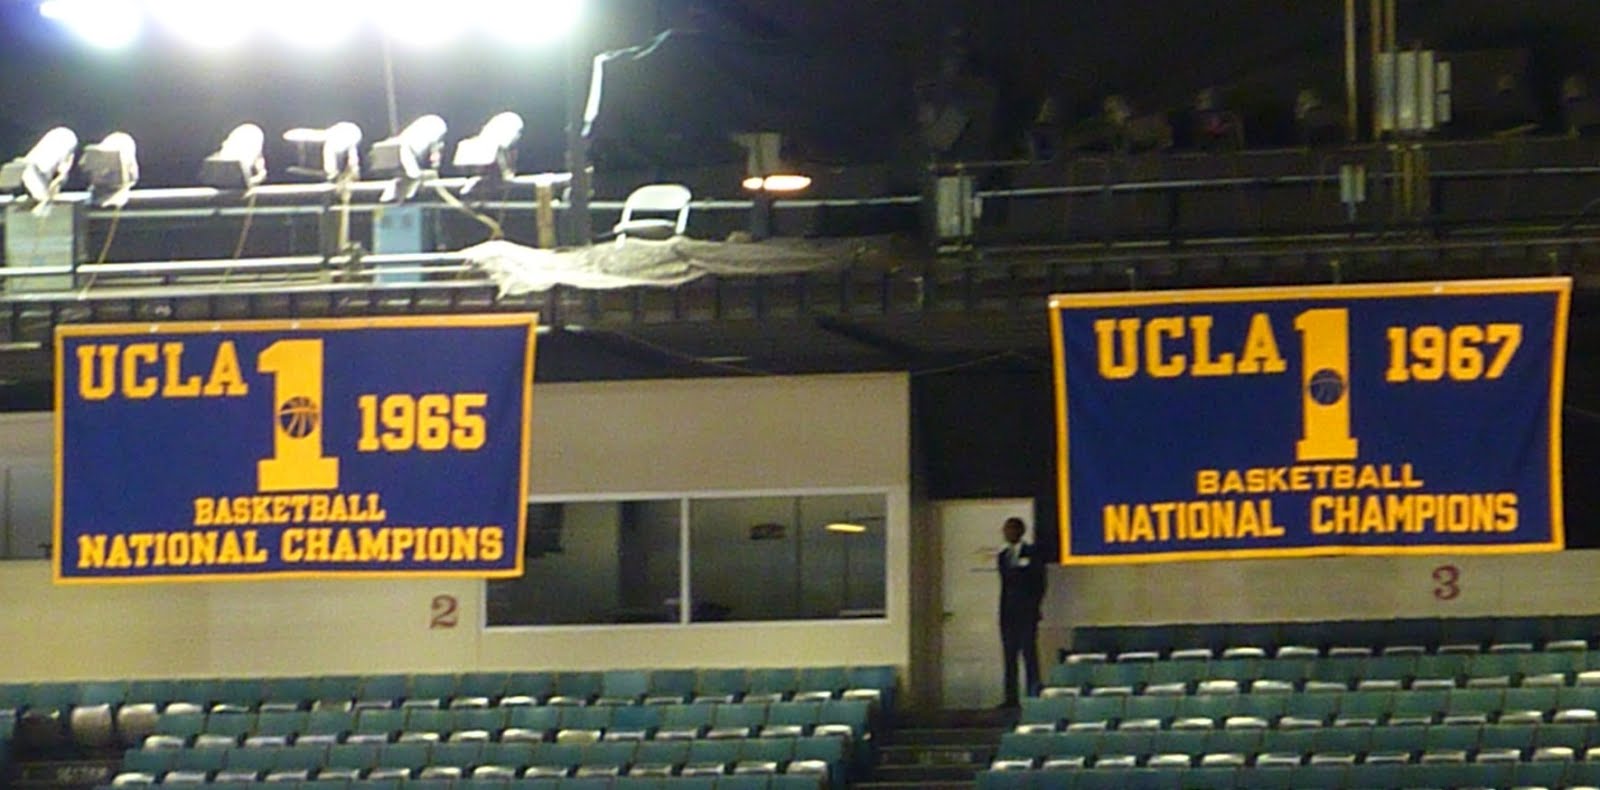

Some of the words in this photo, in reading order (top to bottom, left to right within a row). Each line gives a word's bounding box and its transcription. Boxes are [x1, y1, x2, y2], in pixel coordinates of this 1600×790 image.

[1095, 313, 1286, 379] UCLA
[1295, 308, 1358, 461] 1
[1386, 324, 1522, 382] 1967
[76, 341, 248, 400] UCLA
[258, 339, 340, 491] 1
[358, 394, 487, 452] 1965
[1198, 463, 1424, 495] BASKETBALL
[194, 494, 386, 527] BASKETBALL
[1104, 500, 1285, 543] NATIONAL
[1311, 494, 1518, 534] CHAMPIONS
[78, 530, 268, 569] NATIONAL
[282, 526, 503, 562] CHAMPIONS
[1433, 564, 1460, 600] 3
[431, 595, 458, 628] 2
